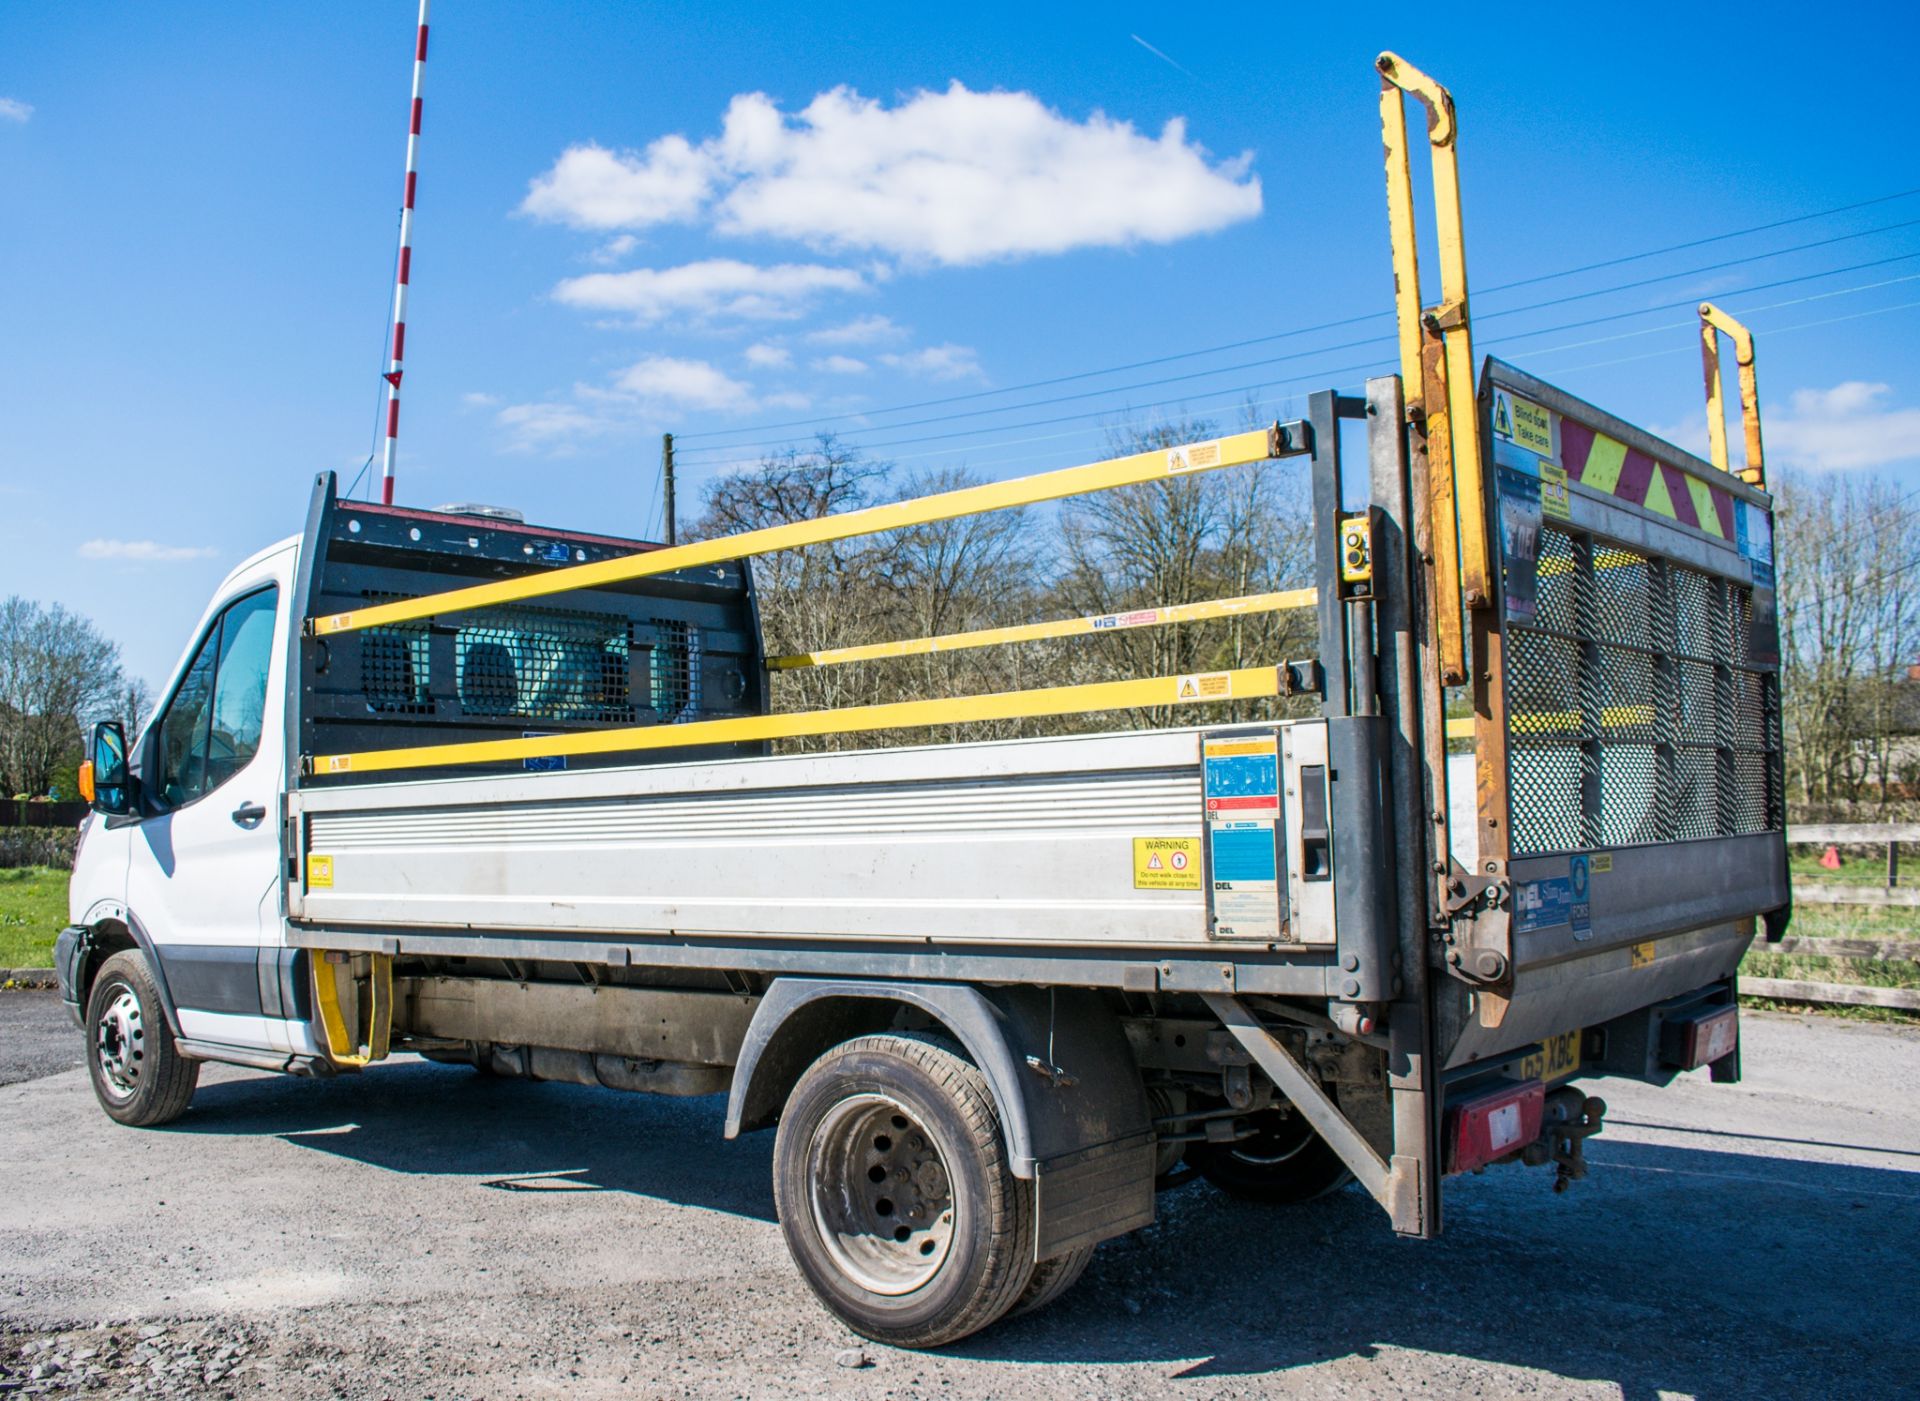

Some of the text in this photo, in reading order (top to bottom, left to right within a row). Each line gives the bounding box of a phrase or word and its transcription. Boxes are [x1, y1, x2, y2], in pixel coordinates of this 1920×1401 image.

[1515, 405, 1532, 423] Blind
[1517, 423, 1549, 448] Take care
[1145, 840, 1189, 850] WARNING
[1215, 882, 1232, 890] DEL
[1548, 1030, 1576, 1074] XBC
